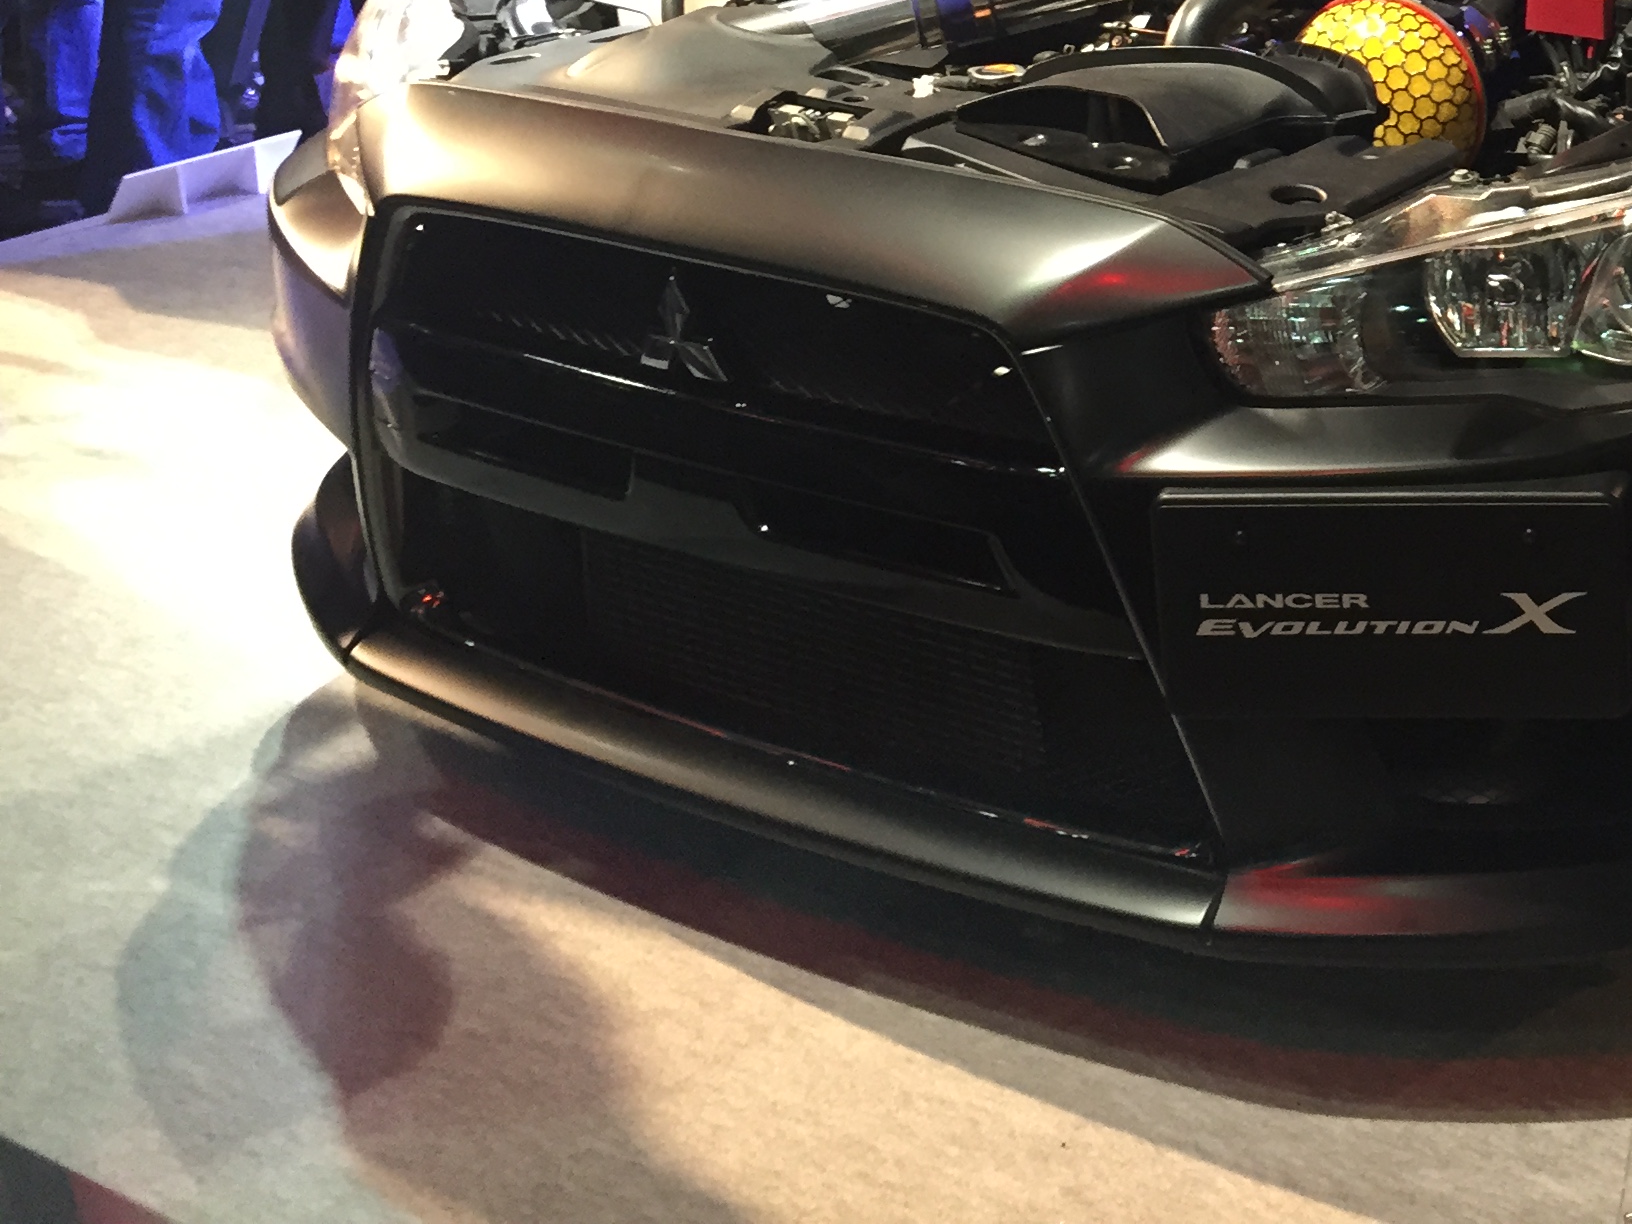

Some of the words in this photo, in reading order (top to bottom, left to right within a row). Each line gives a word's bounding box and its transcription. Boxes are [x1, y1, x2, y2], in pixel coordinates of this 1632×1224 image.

[1195, 618, 1480, 638] EVOLUTION
[1481, 591, 1588, 635] X
[1199, 593, 1370, 609] LANCER
